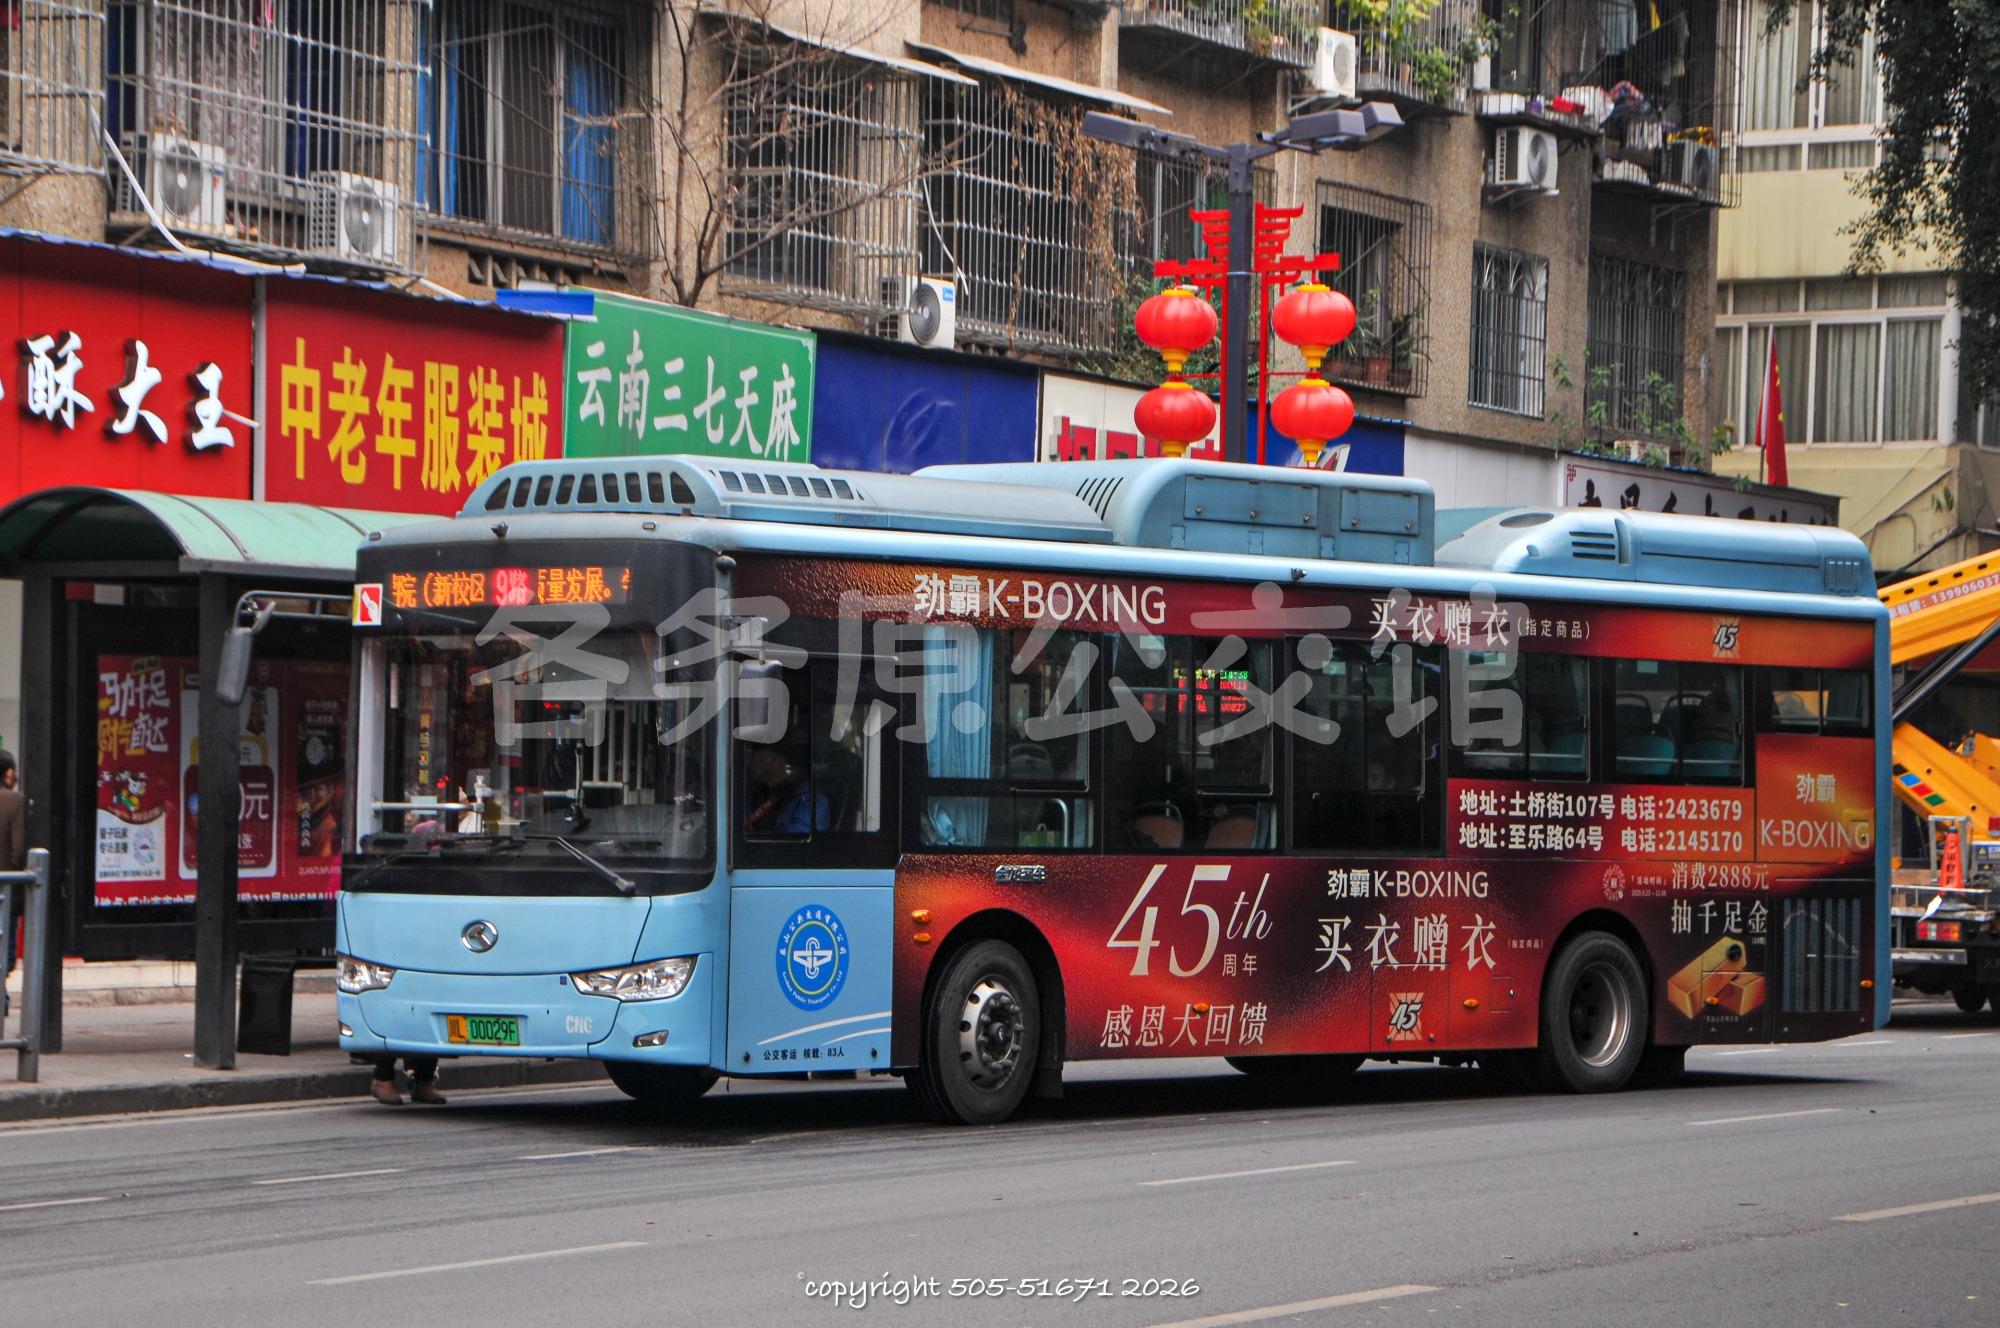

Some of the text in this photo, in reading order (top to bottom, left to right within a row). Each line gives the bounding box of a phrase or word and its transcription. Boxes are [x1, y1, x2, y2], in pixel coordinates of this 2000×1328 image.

[0, 330, 235, 450] 酥大王
[577, 329, 800, 462] 云南三七天麻
[281, 337, 548, 494] 中老年服装城
[1369, 598, 1510, 648] 买衣赠衣
[1796, 774, 1836, 804] 劲霸
[1760, 819, 1871, 849] K-BOXING
[1671, 862, 1769, 890] 消费2888元
[1671, 900, 1768, 934] 抽千足金
[1315, 913, 1496, 972] 买衣赠衣
[1222, 953, 1258, 977] 周年
[565, 1015, 593, 1034] CNG
[1100, 1002, 1268, 1048] 感恩大回馈
[763, 1049, 797, 1061] 公交客运
